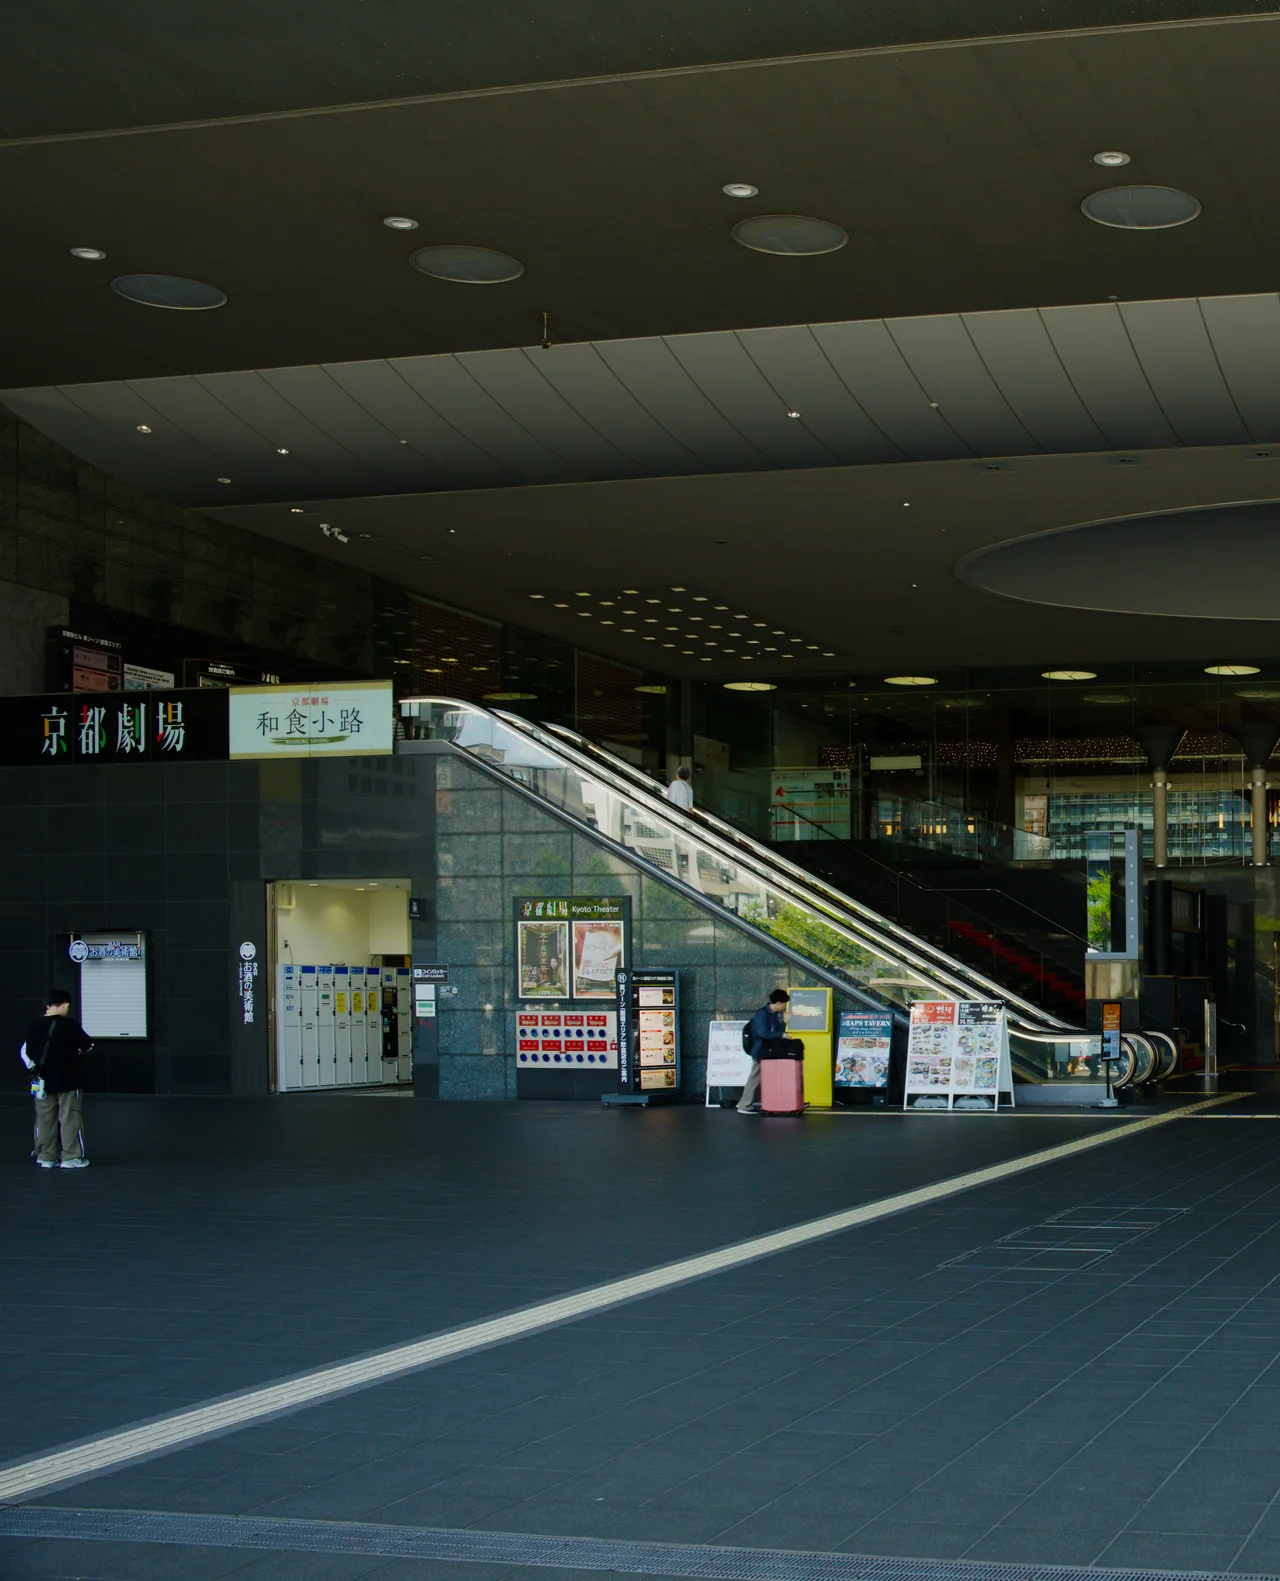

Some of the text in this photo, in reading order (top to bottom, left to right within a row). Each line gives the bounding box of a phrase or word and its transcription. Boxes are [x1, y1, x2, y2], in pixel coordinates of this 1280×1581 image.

[292, 697, 329, 706] 京都劇場
[40, 702, 186, 757] 京都劇場
[256, 708, 364, 736] 和食小路
[522, 901, 568, 917] 京都劇場
[571, 905, 620, 915] Kyoto Theater
[243, 962, 254, 1023] お酒の美術館
